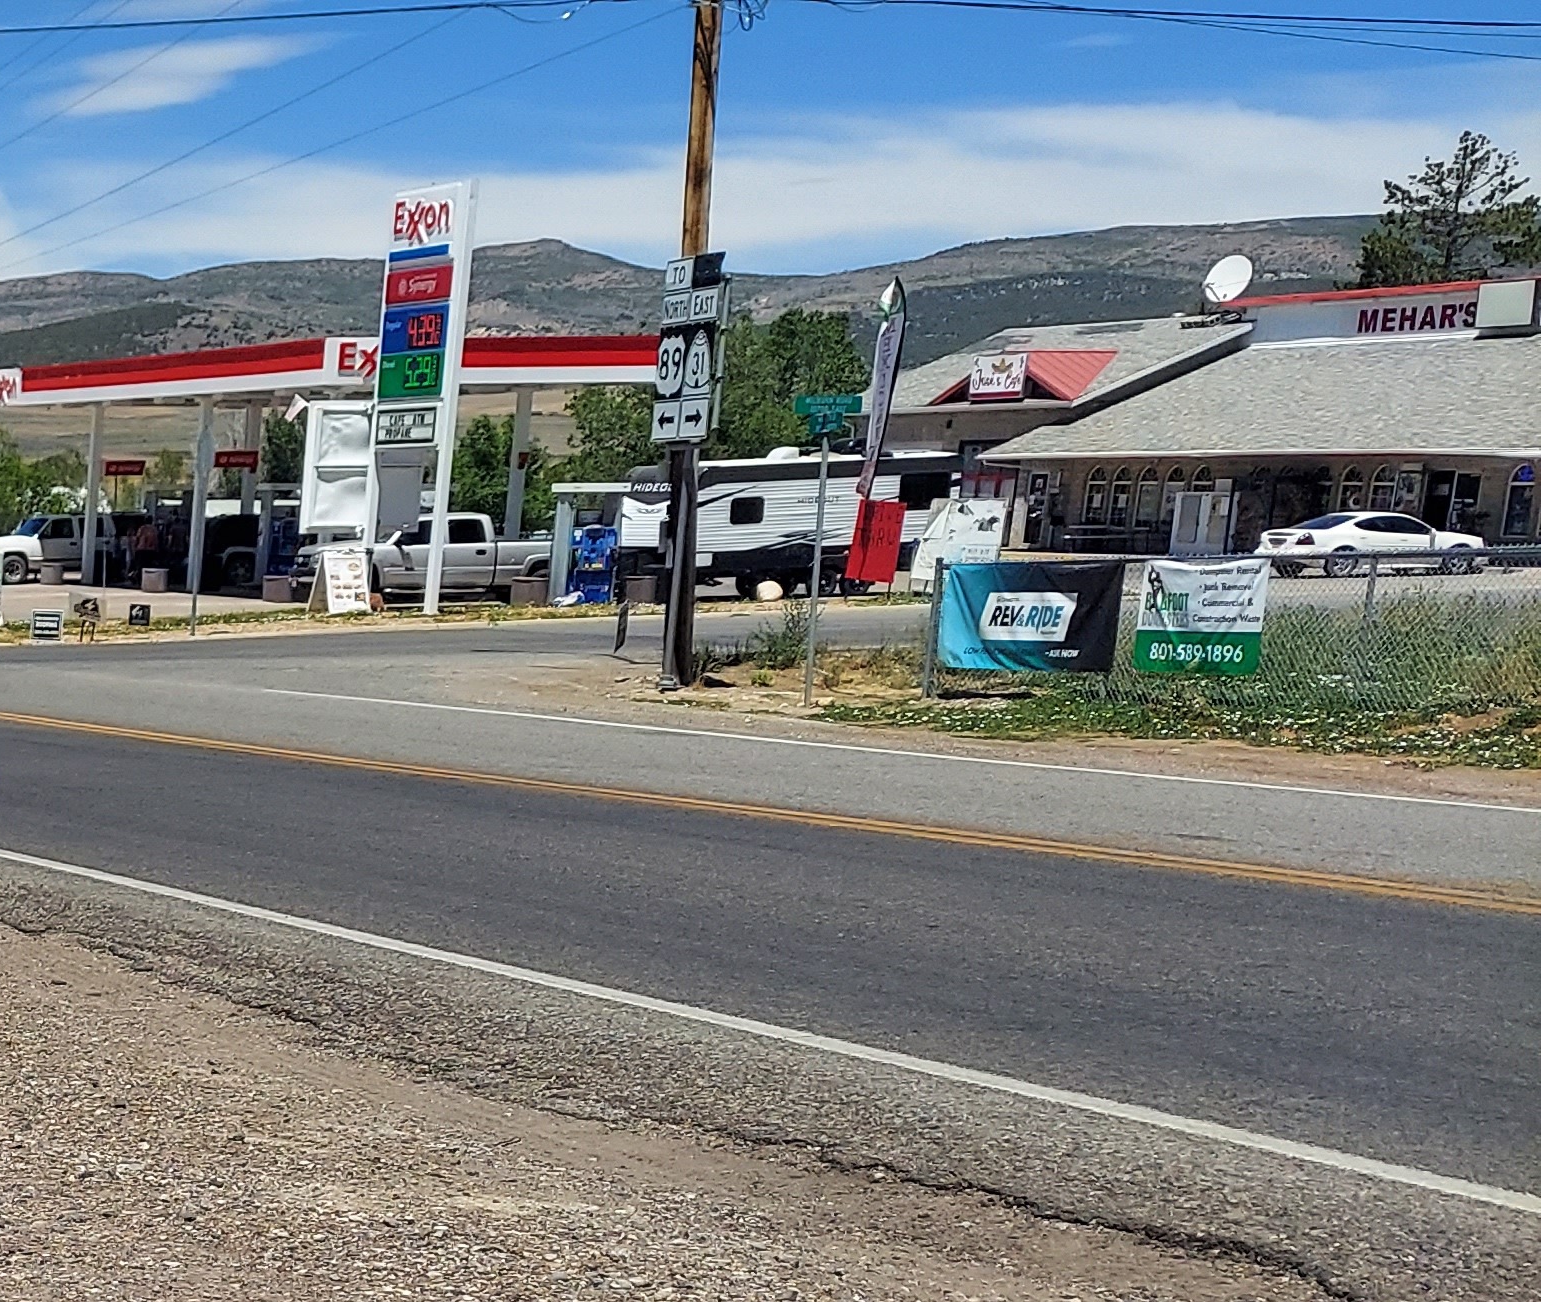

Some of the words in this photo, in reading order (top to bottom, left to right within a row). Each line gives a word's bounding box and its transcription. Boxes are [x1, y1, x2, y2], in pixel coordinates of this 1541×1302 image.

[393, 200, 452, 242] Exxon
[673, 266, 686, 284] TO
[694, 295, 714, 315] EAST
[1357, 302, 1478, 334] MEHAR'S
[659, 347, 682, 381] 89
[691, 351, 705, 376] 31
[633, 482, 672, 493] HIDEO
[797, 496, 840, 504] HIDEUT
[1145, 592, 1189, 611] BGFOOT
